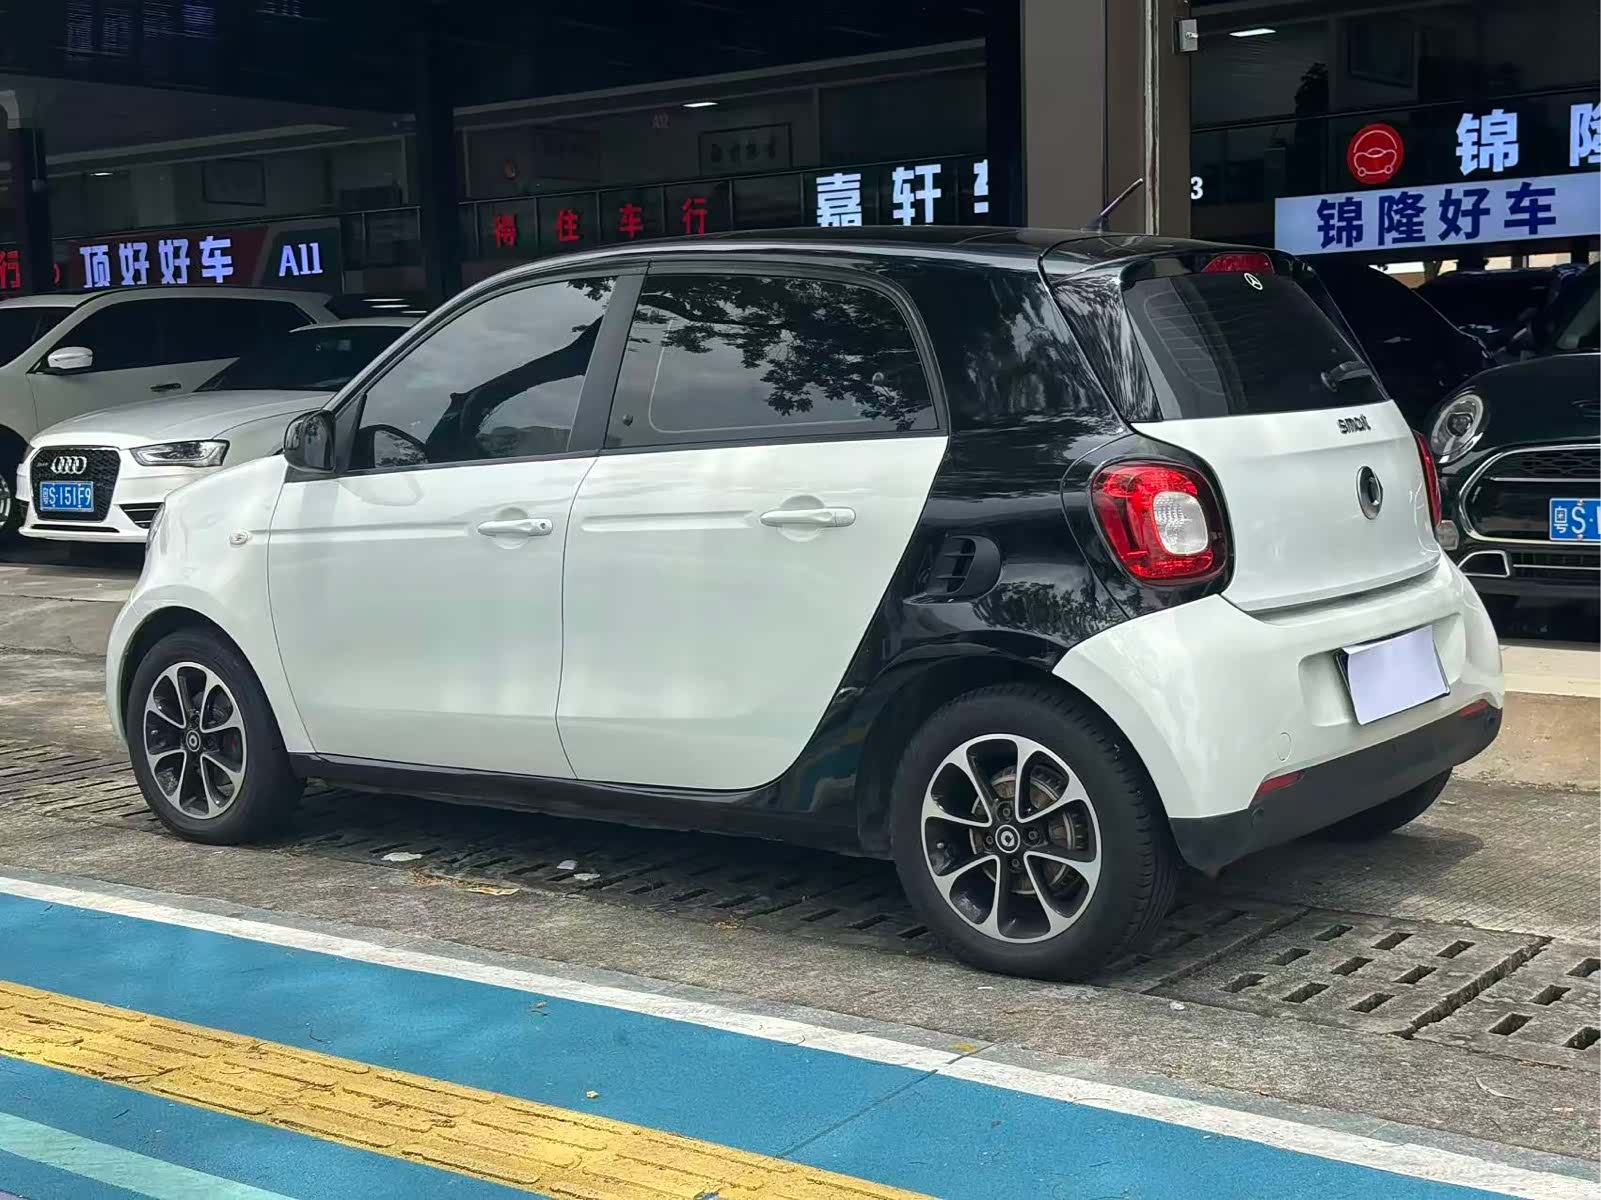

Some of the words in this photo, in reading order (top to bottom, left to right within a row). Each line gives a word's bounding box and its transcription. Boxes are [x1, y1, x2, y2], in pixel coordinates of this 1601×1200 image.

[1316, 181, 1557, 249] 锦隆好车
[79, 235, 234, 288] 顶好好车
[1337, 414, 1372, 435] smart
[1553, 506, 1600, 535] 粤S·
